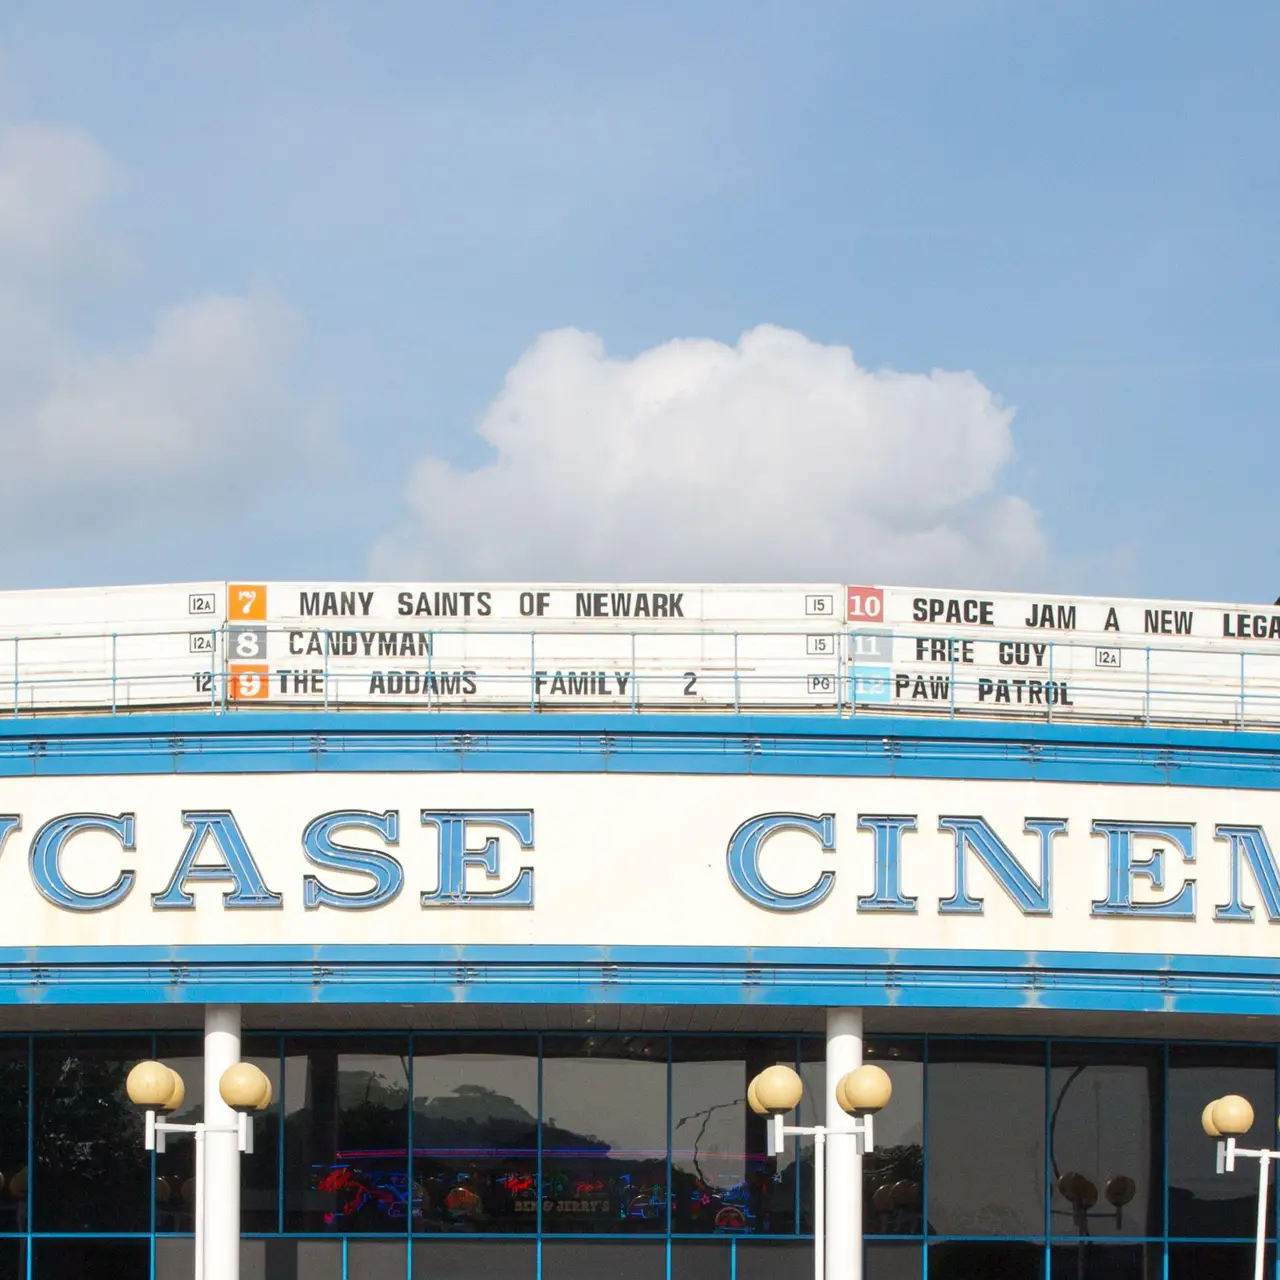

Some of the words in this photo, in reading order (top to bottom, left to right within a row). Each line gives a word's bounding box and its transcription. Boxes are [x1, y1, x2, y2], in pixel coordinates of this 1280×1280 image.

[193, 598, 210, 610] 12A
[239, 590, 256, 614] 7
[300, 592, 373, 616] MANY
[398, 592, 491, 616] SAINTS
[519, 592, 549, 616] OF
[575, 592, 684, 618] NEWARK
[813, 598, 825, 612] 15
[850, 596, 880, 616] 10
[913, 598, 994, 625] SPACE
[1025, 603, 1076, 629] JAM
[1103, 608, 1120, 631] A
[1144, 609, 1193, 635] NEW
[236, 632, 259, 657] 8
[289, 631, 433, 657] CANDYMAN
[814, 637, 826, 652] 15
[853, 636, 880, 656] 11
[916, 638, 974, 663] FREE
[999, 642, 1047, 666] GUY
[1098, 649, 1117, 664] 12A
[239, 672, 261, 696] 9
[276, 669, 323, 693] THE
[369, 670, 476, 695] ADDAMS
[535, 671, 630, 696] FAMILY
[683, 672, 697, 697] 2
[895, 674, 950, 699] PAW
[978, 678, 1073, 706] PATROL
[557, 1200, 610, 1213] JERRY'S
